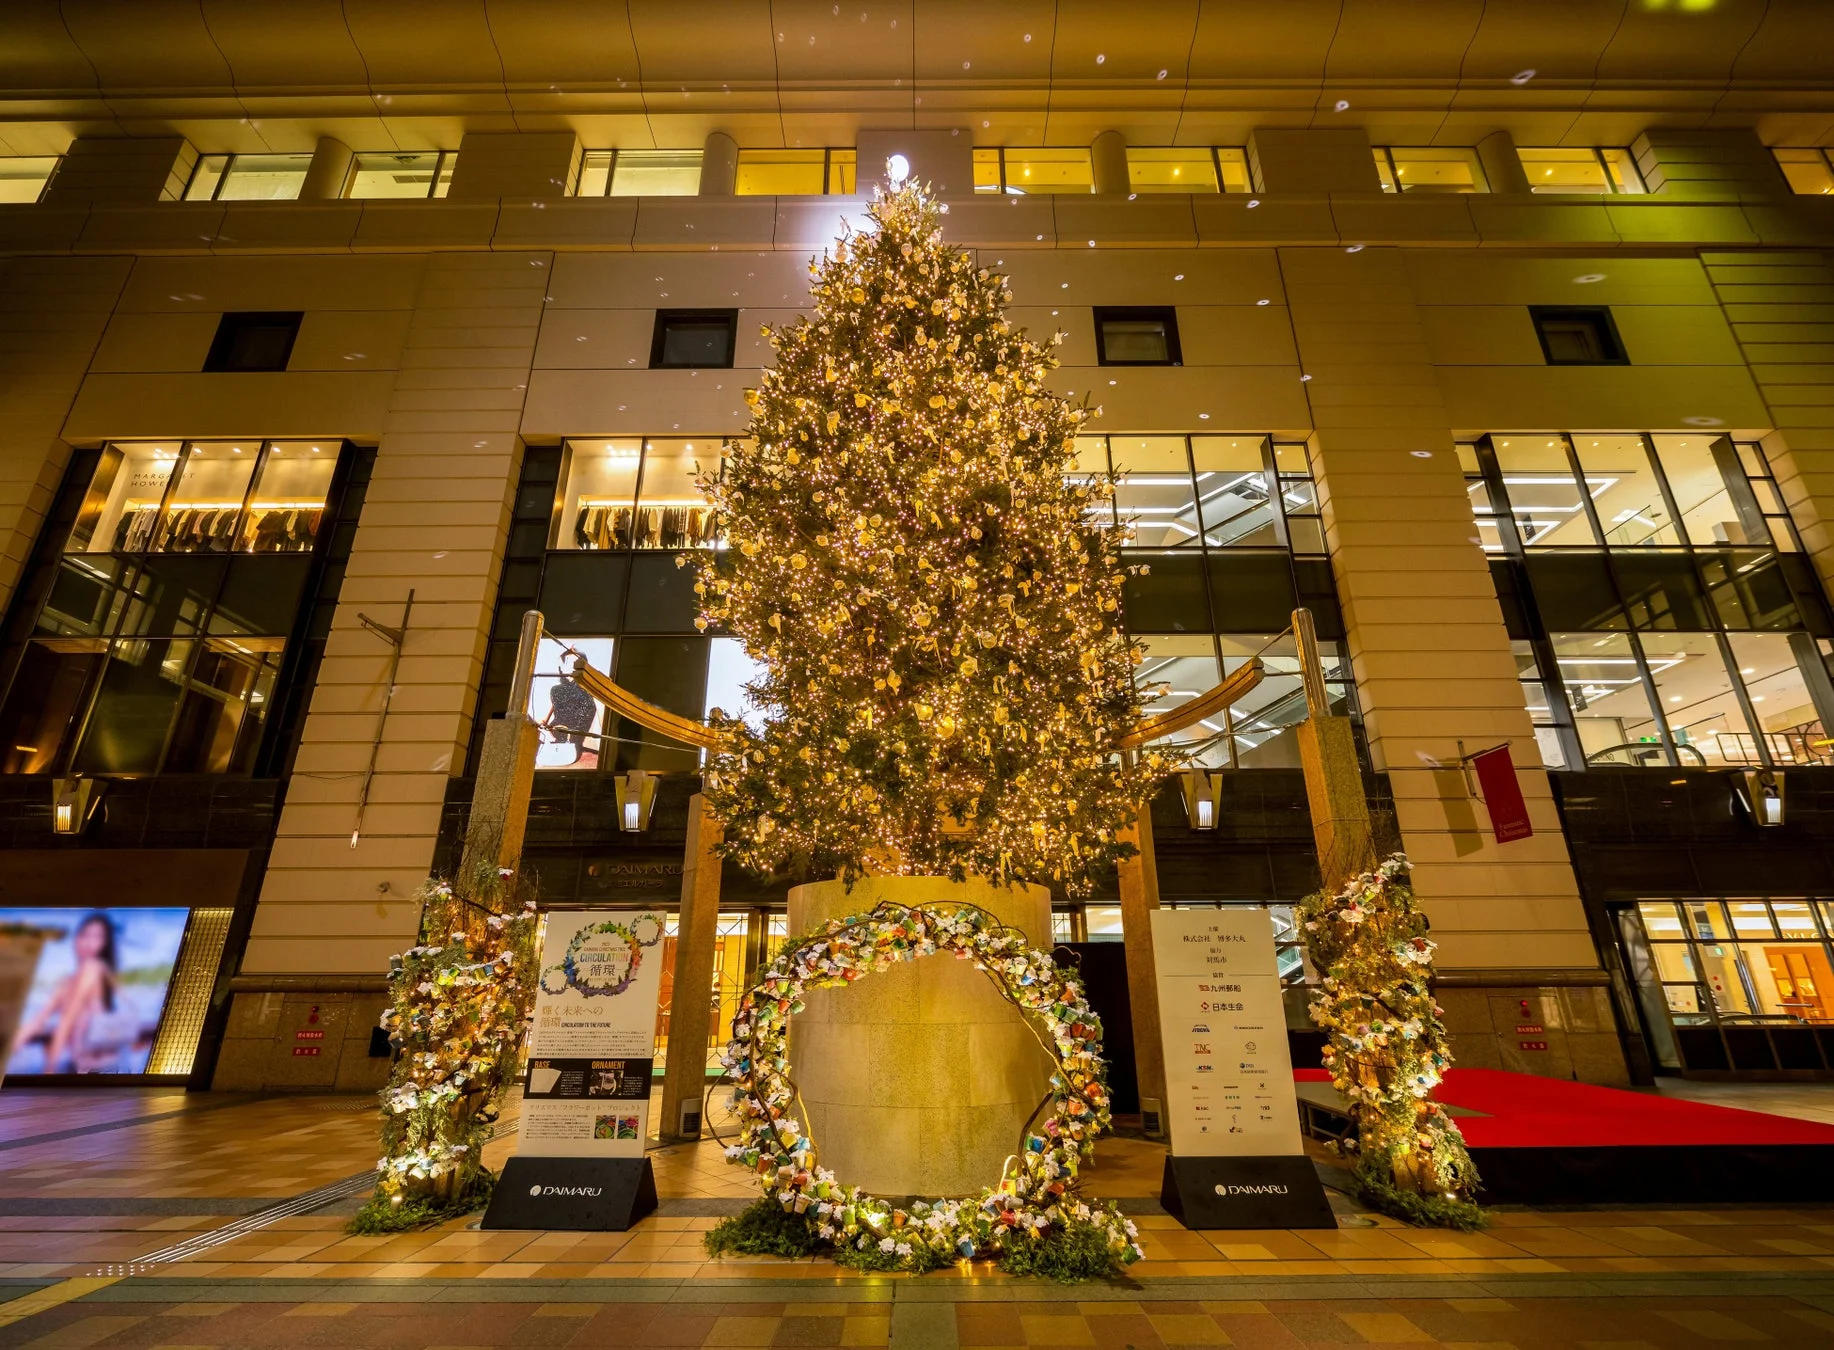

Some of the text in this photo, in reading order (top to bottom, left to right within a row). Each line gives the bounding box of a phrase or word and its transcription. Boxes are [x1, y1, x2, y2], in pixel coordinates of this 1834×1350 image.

[580, 952, 629, 963] CIRCULATION
[590, 964, 616, 976] 循環
[1211, 984, 1241, 992] 九州郵船
[1212, 1002, 1244, 1011] 日本生命
[534, 1061, 626, 1069] BASE ORNAMENT
[542, 1186, 602, 1197] DAIMARU
[1228, 1184, 1289, 1195] DAIMARU
